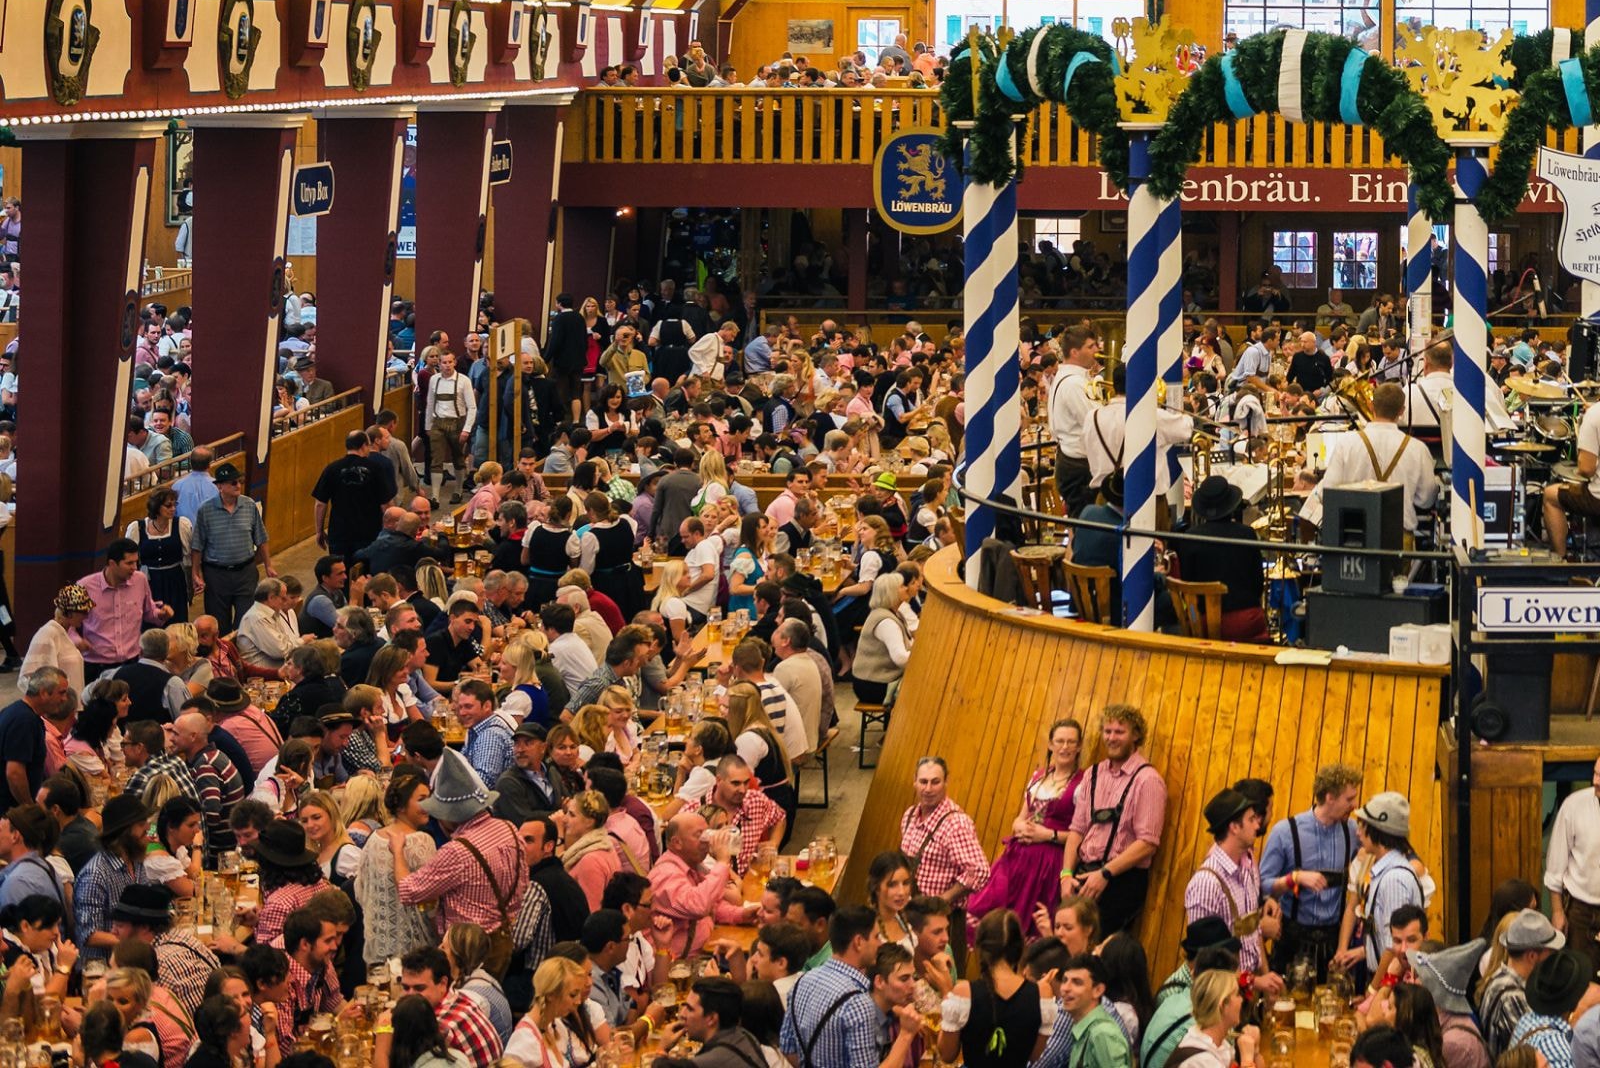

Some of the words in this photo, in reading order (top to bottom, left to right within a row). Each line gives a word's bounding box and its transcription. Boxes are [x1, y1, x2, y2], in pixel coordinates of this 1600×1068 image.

[1097, 171, 1321, 203] Lenbräu.
[891, 200, 952, 213] LÖWENBRÄU
[1572, 263, 1595, 273] BERT
